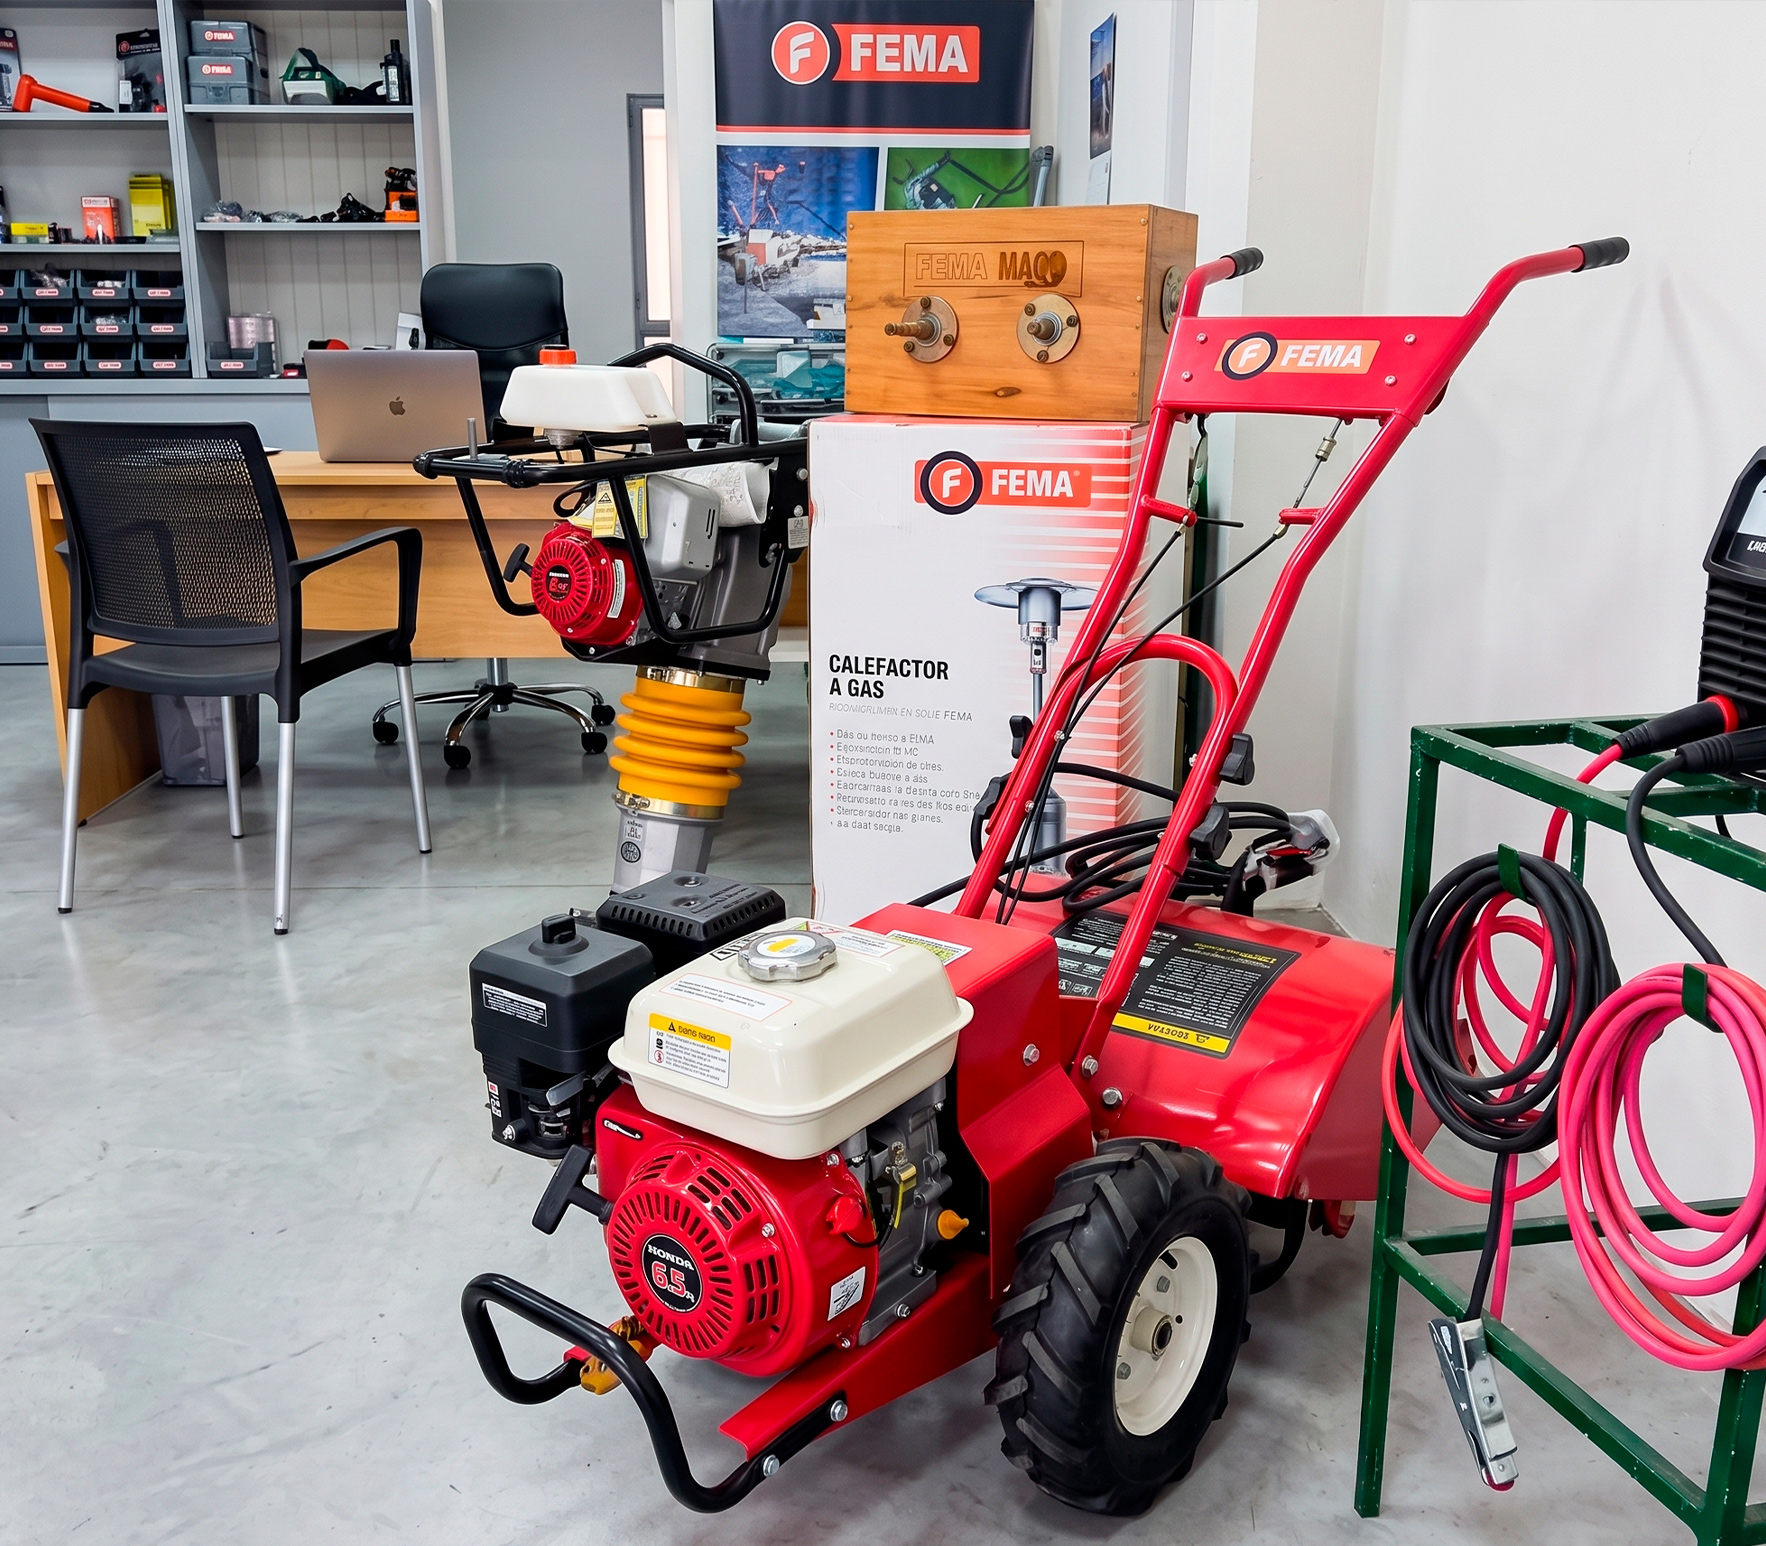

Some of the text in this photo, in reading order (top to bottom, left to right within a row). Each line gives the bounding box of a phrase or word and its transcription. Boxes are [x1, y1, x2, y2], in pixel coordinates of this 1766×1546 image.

[850, 33, 969, 73] FEMA
[916, 253, 988, 280] FEMA
[1280, 344, 1363, 368] FEMA
[991, 469, 1074, 498] FEMA
[829, 654, 949, 681] CALEFACTOR
[829, 677, 885, 699] A GAS
[944, 711, 973, 722] FEMA
[906, 760, 918, 770] de
[647, 1244, 695, 1271] HONDA
